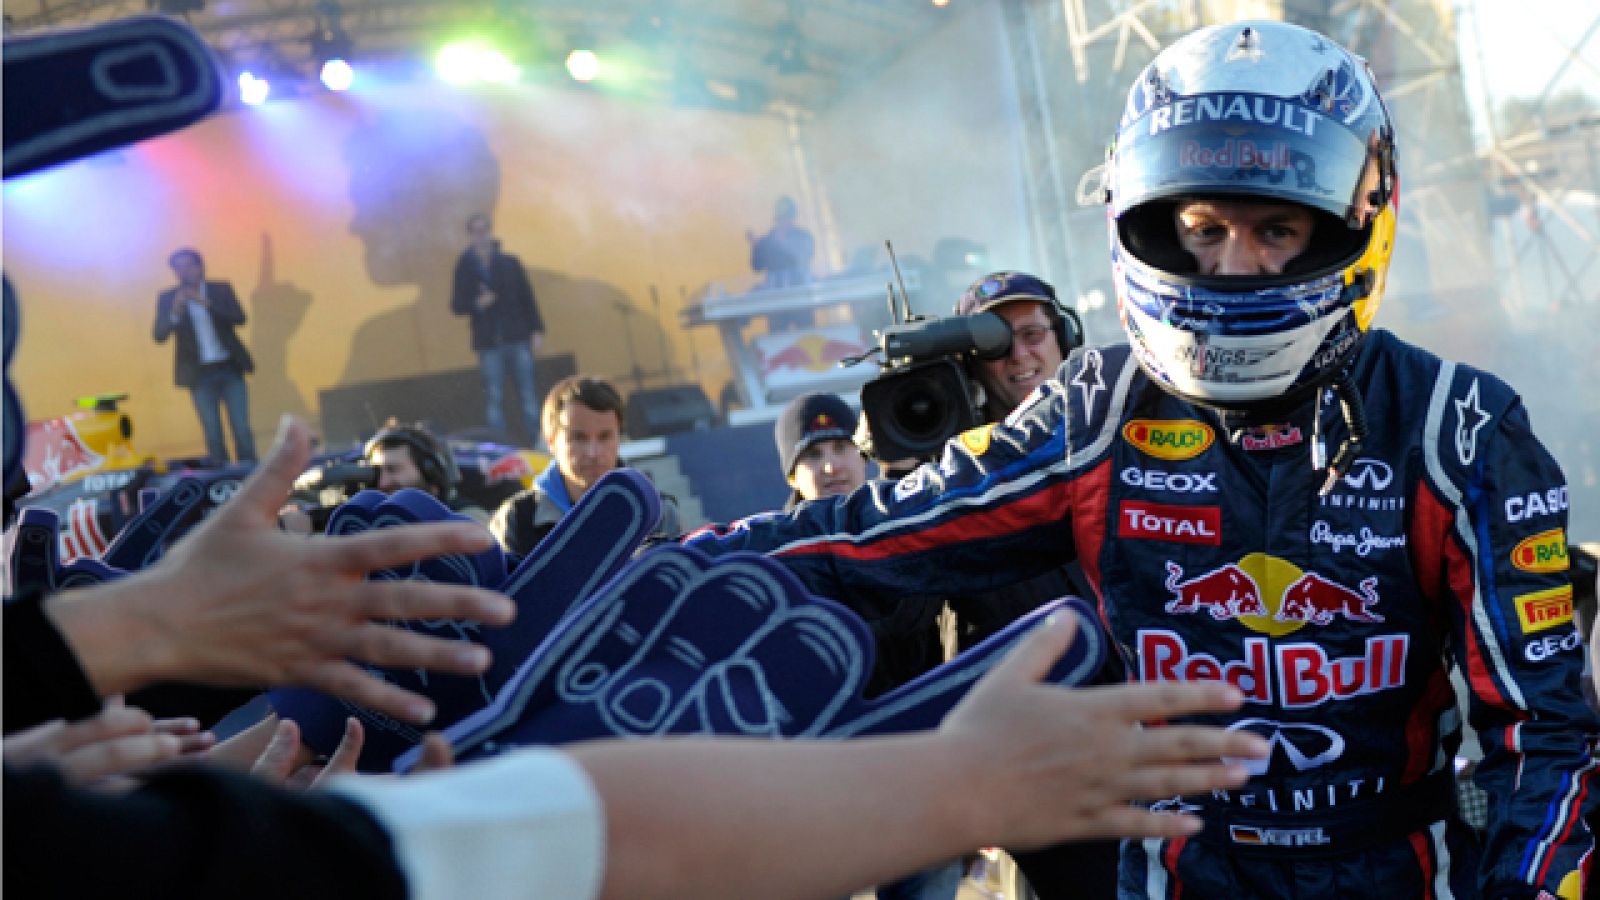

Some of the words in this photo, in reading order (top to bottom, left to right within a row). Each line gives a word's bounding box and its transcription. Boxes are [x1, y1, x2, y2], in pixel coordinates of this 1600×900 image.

[1150, 94, 1322, 137] RENAULT
[1178, 140, 1233, 168] Red
[1237, 139, 1294, 172] Bull
[1150, 428, 1203, 450] RAUCH
[1120, 466, 1218, 492] GEOX
[1319, 494, 1405, 510] INFINITI
[1124, 509, 1216, 537] TOTAL
[1137, 629, 1274, 705] Red
[1275, 633, 1410, 708] Bull
